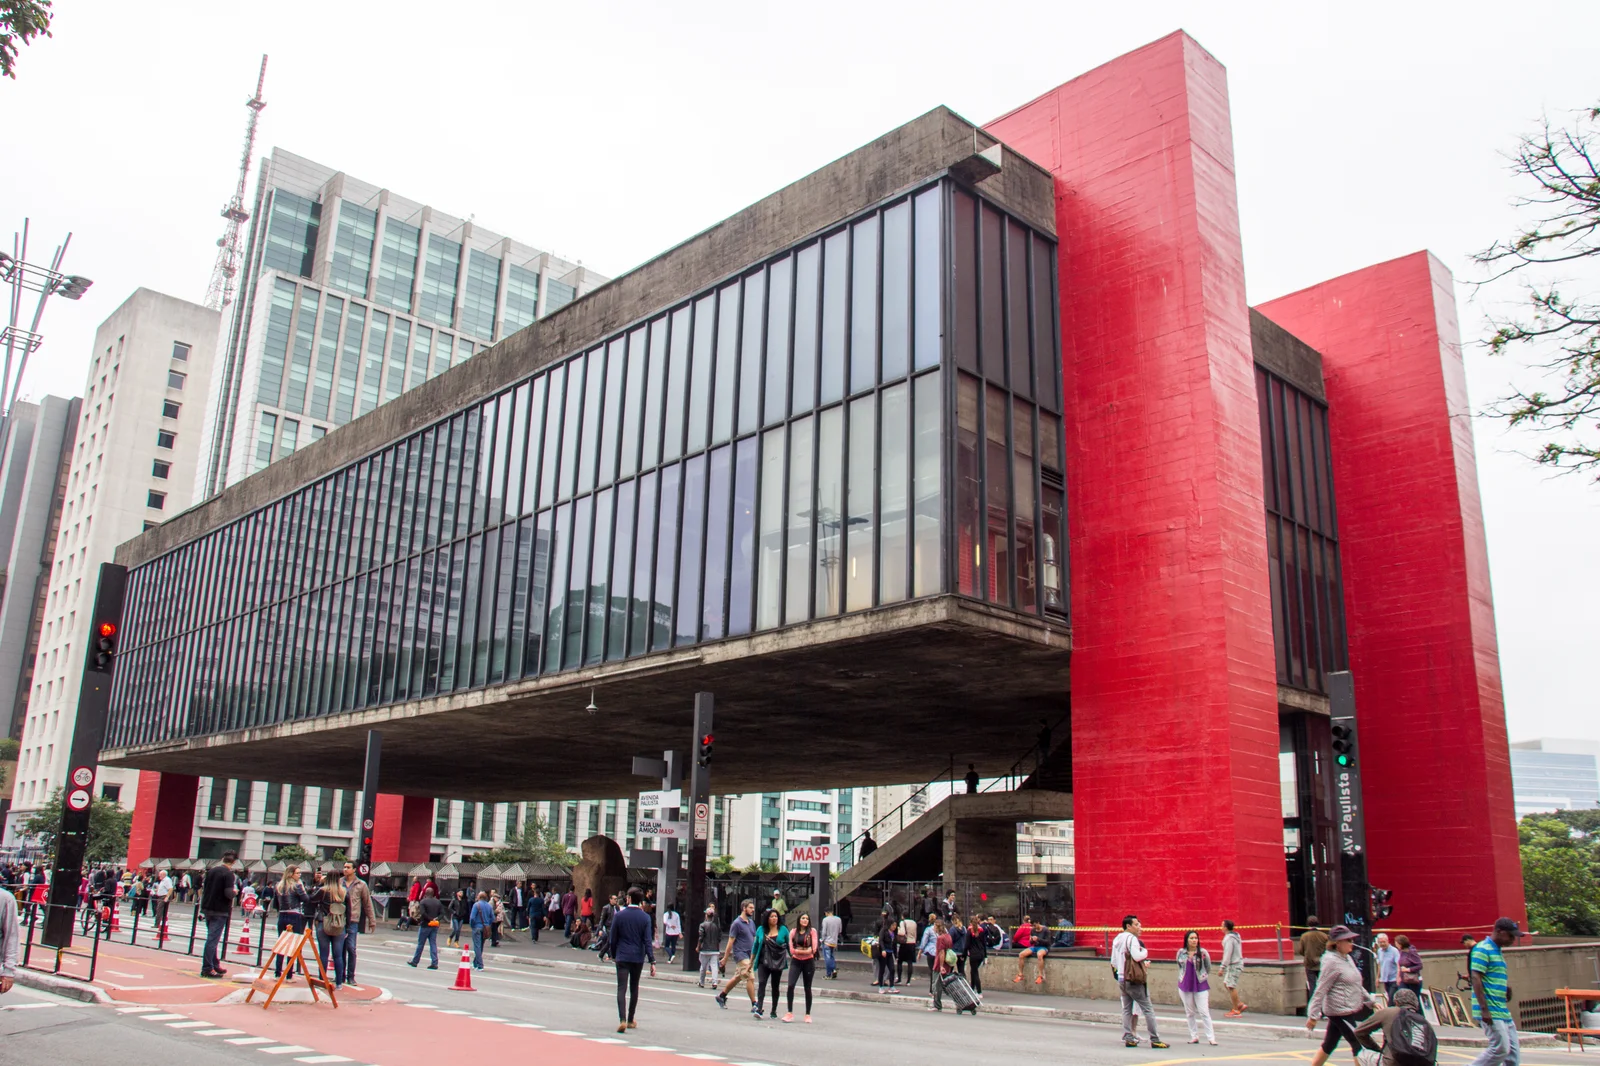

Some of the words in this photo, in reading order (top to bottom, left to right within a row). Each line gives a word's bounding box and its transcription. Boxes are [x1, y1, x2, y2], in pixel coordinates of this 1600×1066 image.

[1338, 772, 1353, 832] Paulista
[793, 846, 829, 861] MASP
[1343, 835, 1355, 856] Av.
